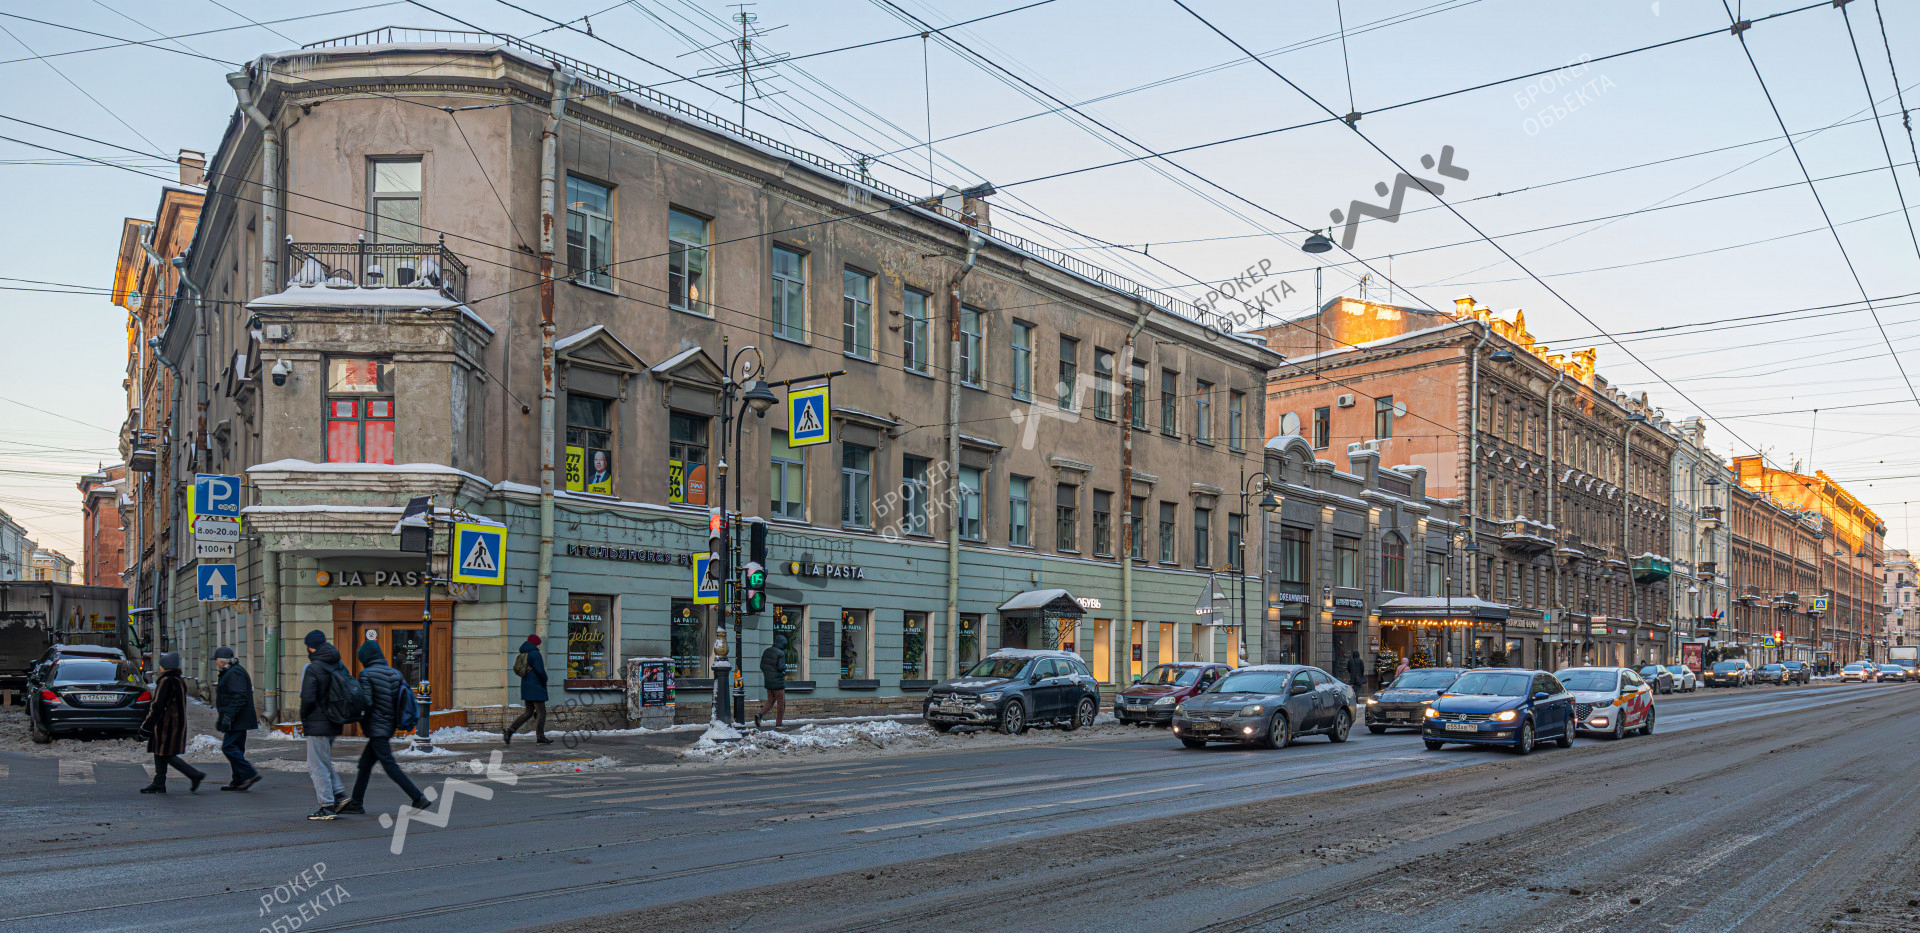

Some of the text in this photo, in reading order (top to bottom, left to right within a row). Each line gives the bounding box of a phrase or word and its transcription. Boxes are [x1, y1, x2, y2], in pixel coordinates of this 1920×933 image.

[566, 463, 579, 472] 34
[566, 473, 580, 482] 00
[208, 480, 232, 510] P
[805, 563, 865, 579] LA PASTA
[340, 571, 362, 586] LA
[751, 573, 763, 585] 05
[1077, 597, 1101, 609] ОБУВЬ
[568, 627, 604, 646] gelato
